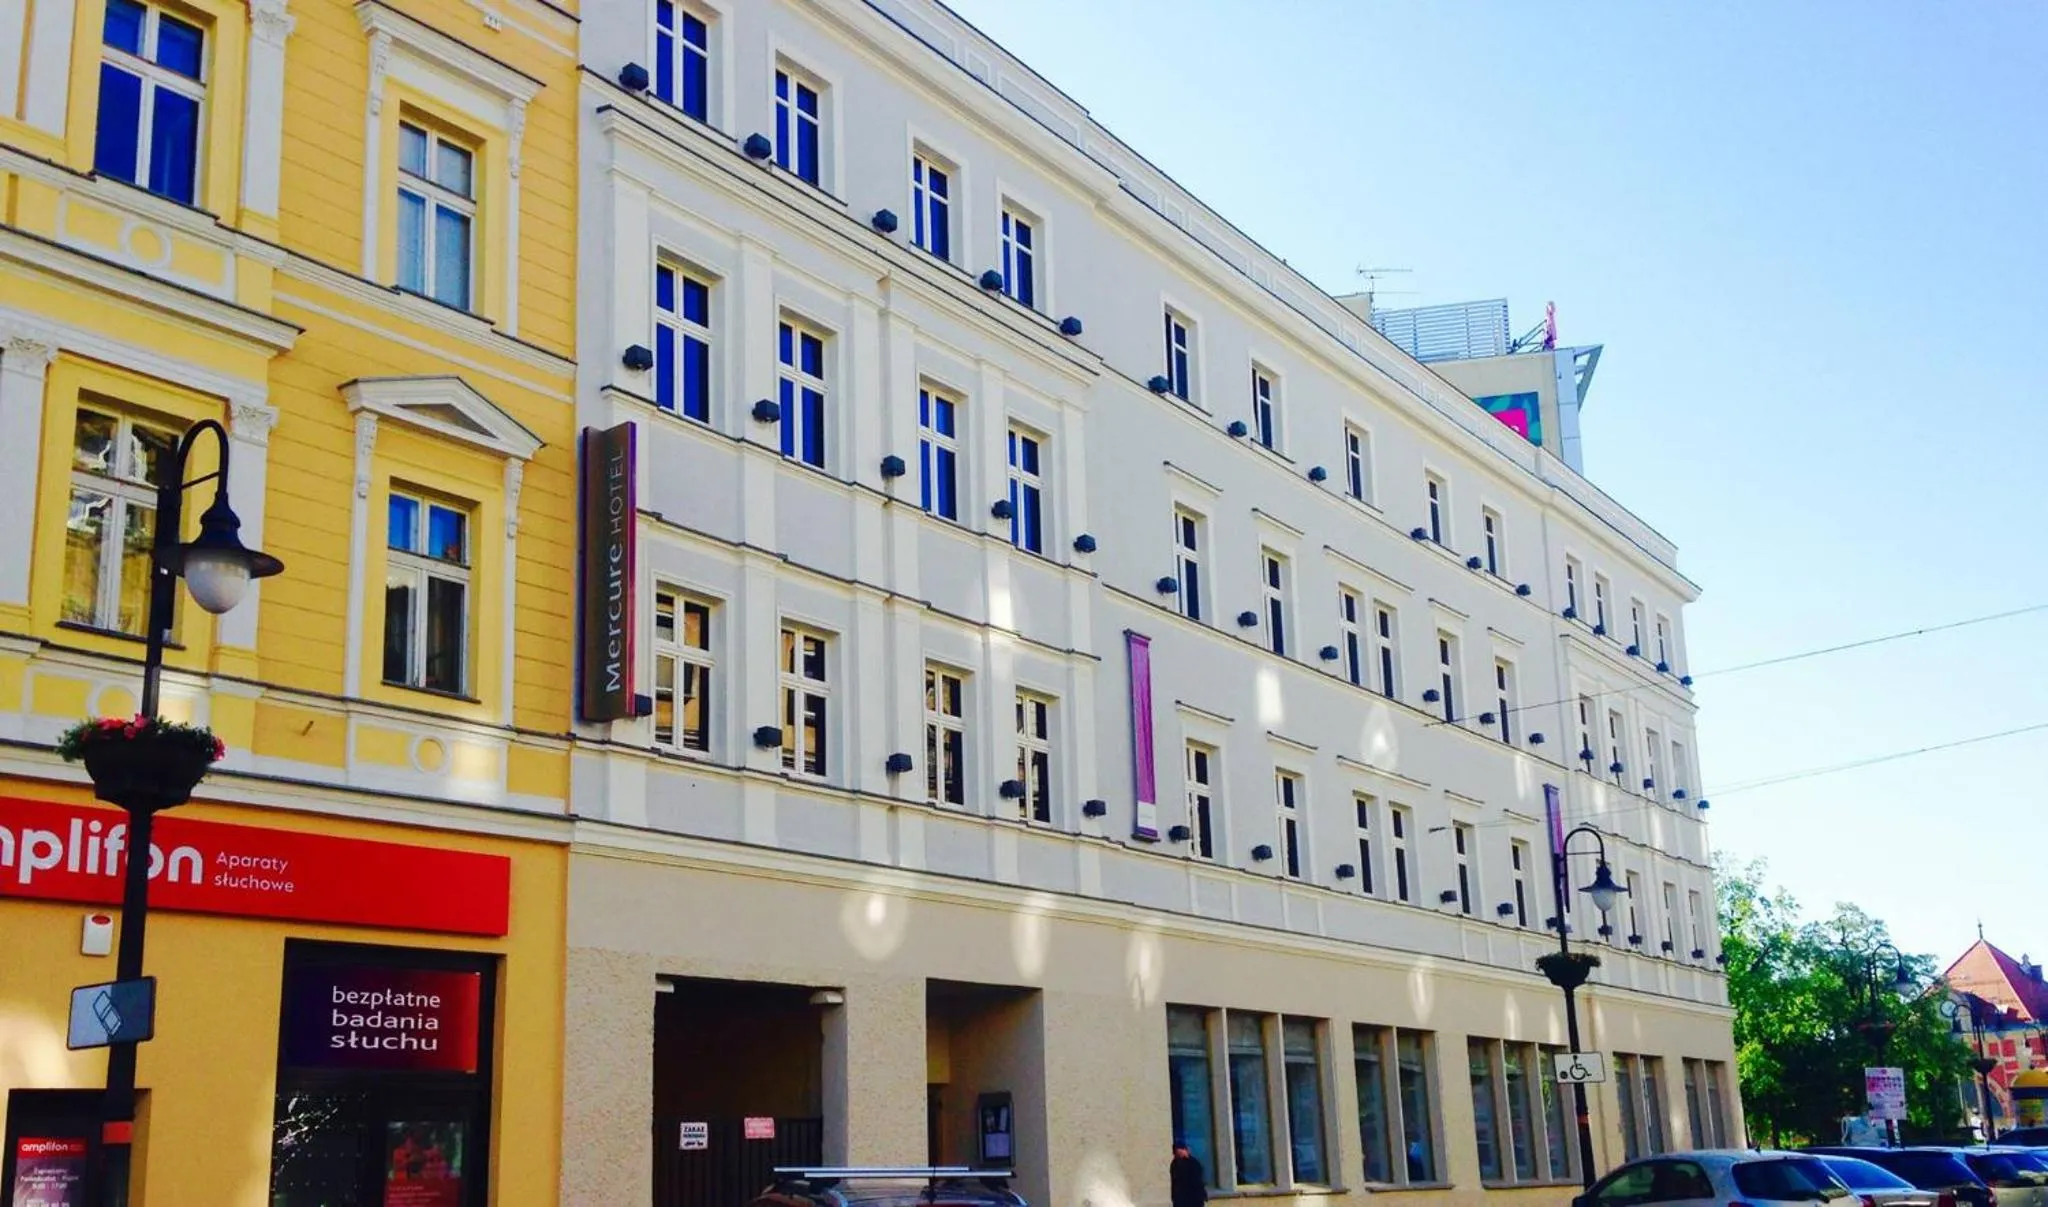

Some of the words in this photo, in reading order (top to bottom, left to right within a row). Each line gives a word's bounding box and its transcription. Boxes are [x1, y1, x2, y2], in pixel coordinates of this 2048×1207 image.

[609, 444, 624, 535] HOTEL
[606, 543, 623, 692] Mercure
[215, 850, 289, 875] Aparaty
[214, 871, 295, 893] słuchowe
[332, 985, 441, 1010] bezpłatne
[331, 1008, 439, 1030] badania
[329, 1030, 438, 1051] słuchu
[21, 1141, 69, 1154] amplifon
